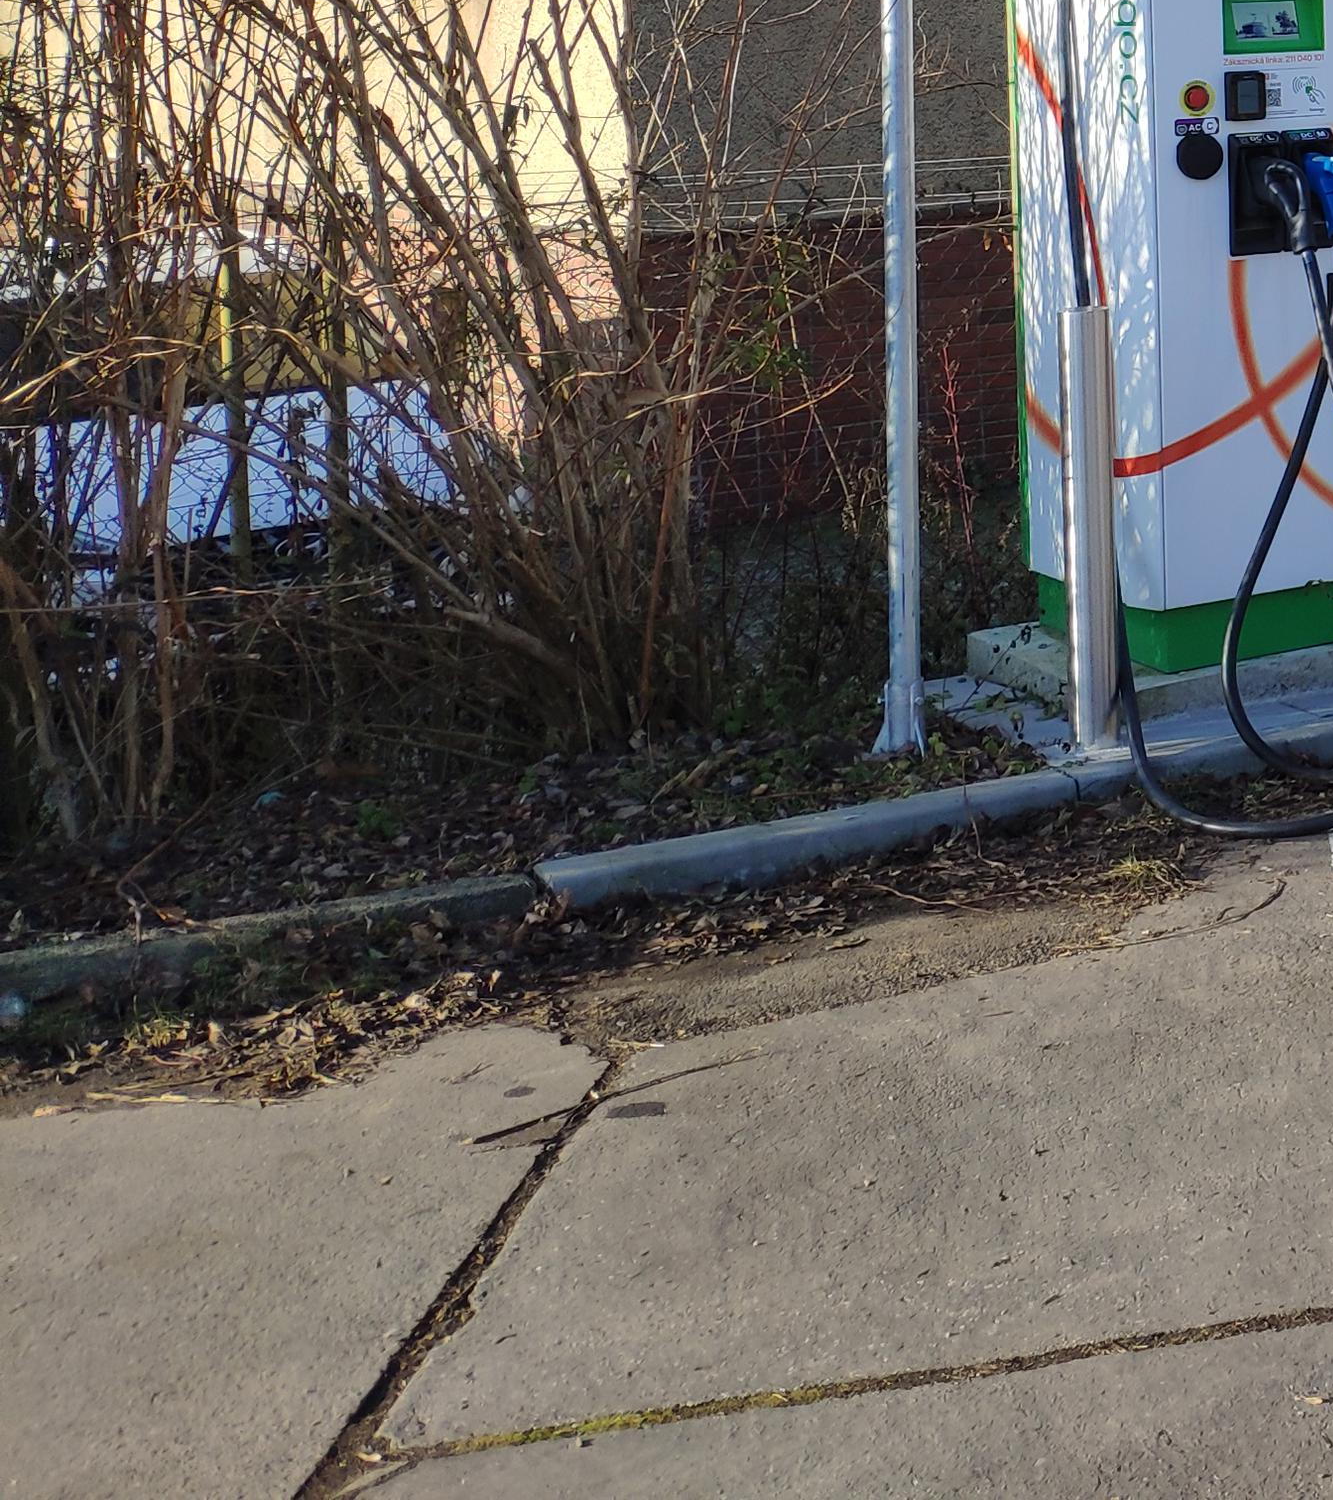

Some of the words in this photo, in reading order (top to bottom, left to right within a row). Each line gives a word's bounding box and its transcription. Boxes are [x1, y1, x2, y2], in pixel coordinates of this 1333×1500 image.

[1297, 54, 1311, 62] 040
[1188, 123, 1201, 131] AC
[1300, 131, 1313, 139] DC
